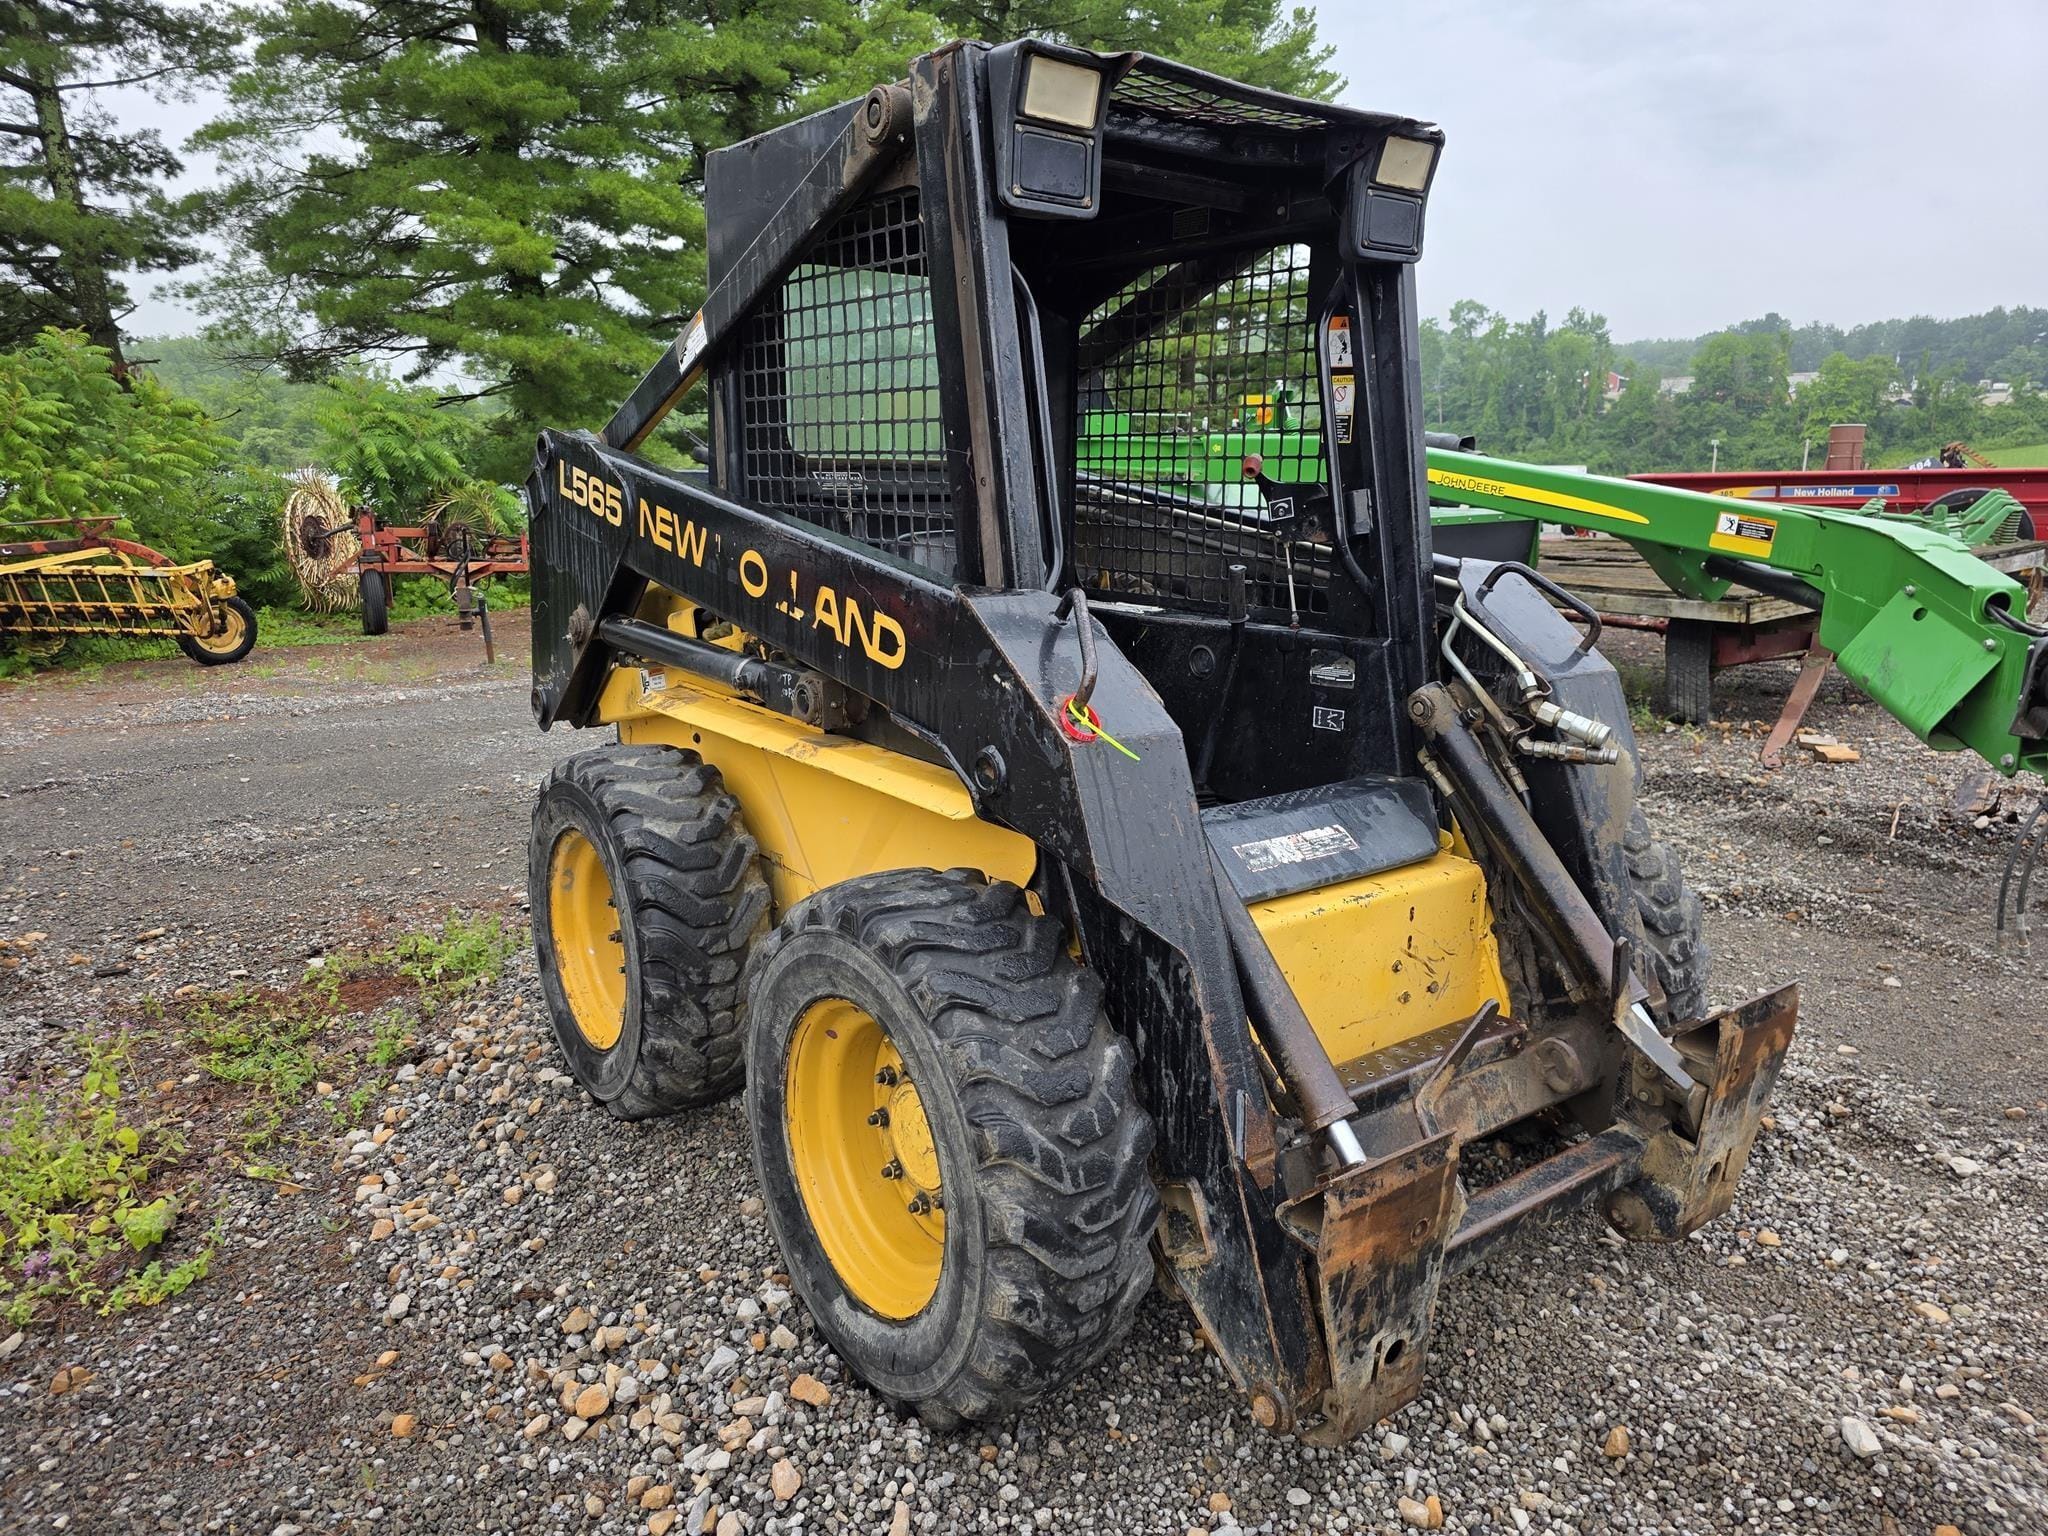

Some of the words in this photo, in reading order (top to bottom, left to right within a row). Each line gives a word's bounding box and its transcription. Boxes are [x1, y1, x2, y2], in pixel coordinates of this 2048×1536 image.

[560, 459, 622, 527] L565
[1436, 474, 1466, 488] JOHN
[1467, 479, 1505, 495] DEERE
[1793, 488, 1817, 496] New
[1819, 486, 1854, 496] Holland
[640, 497, 707, 568] NEW
[715, 533, 906, 670] OLAND
